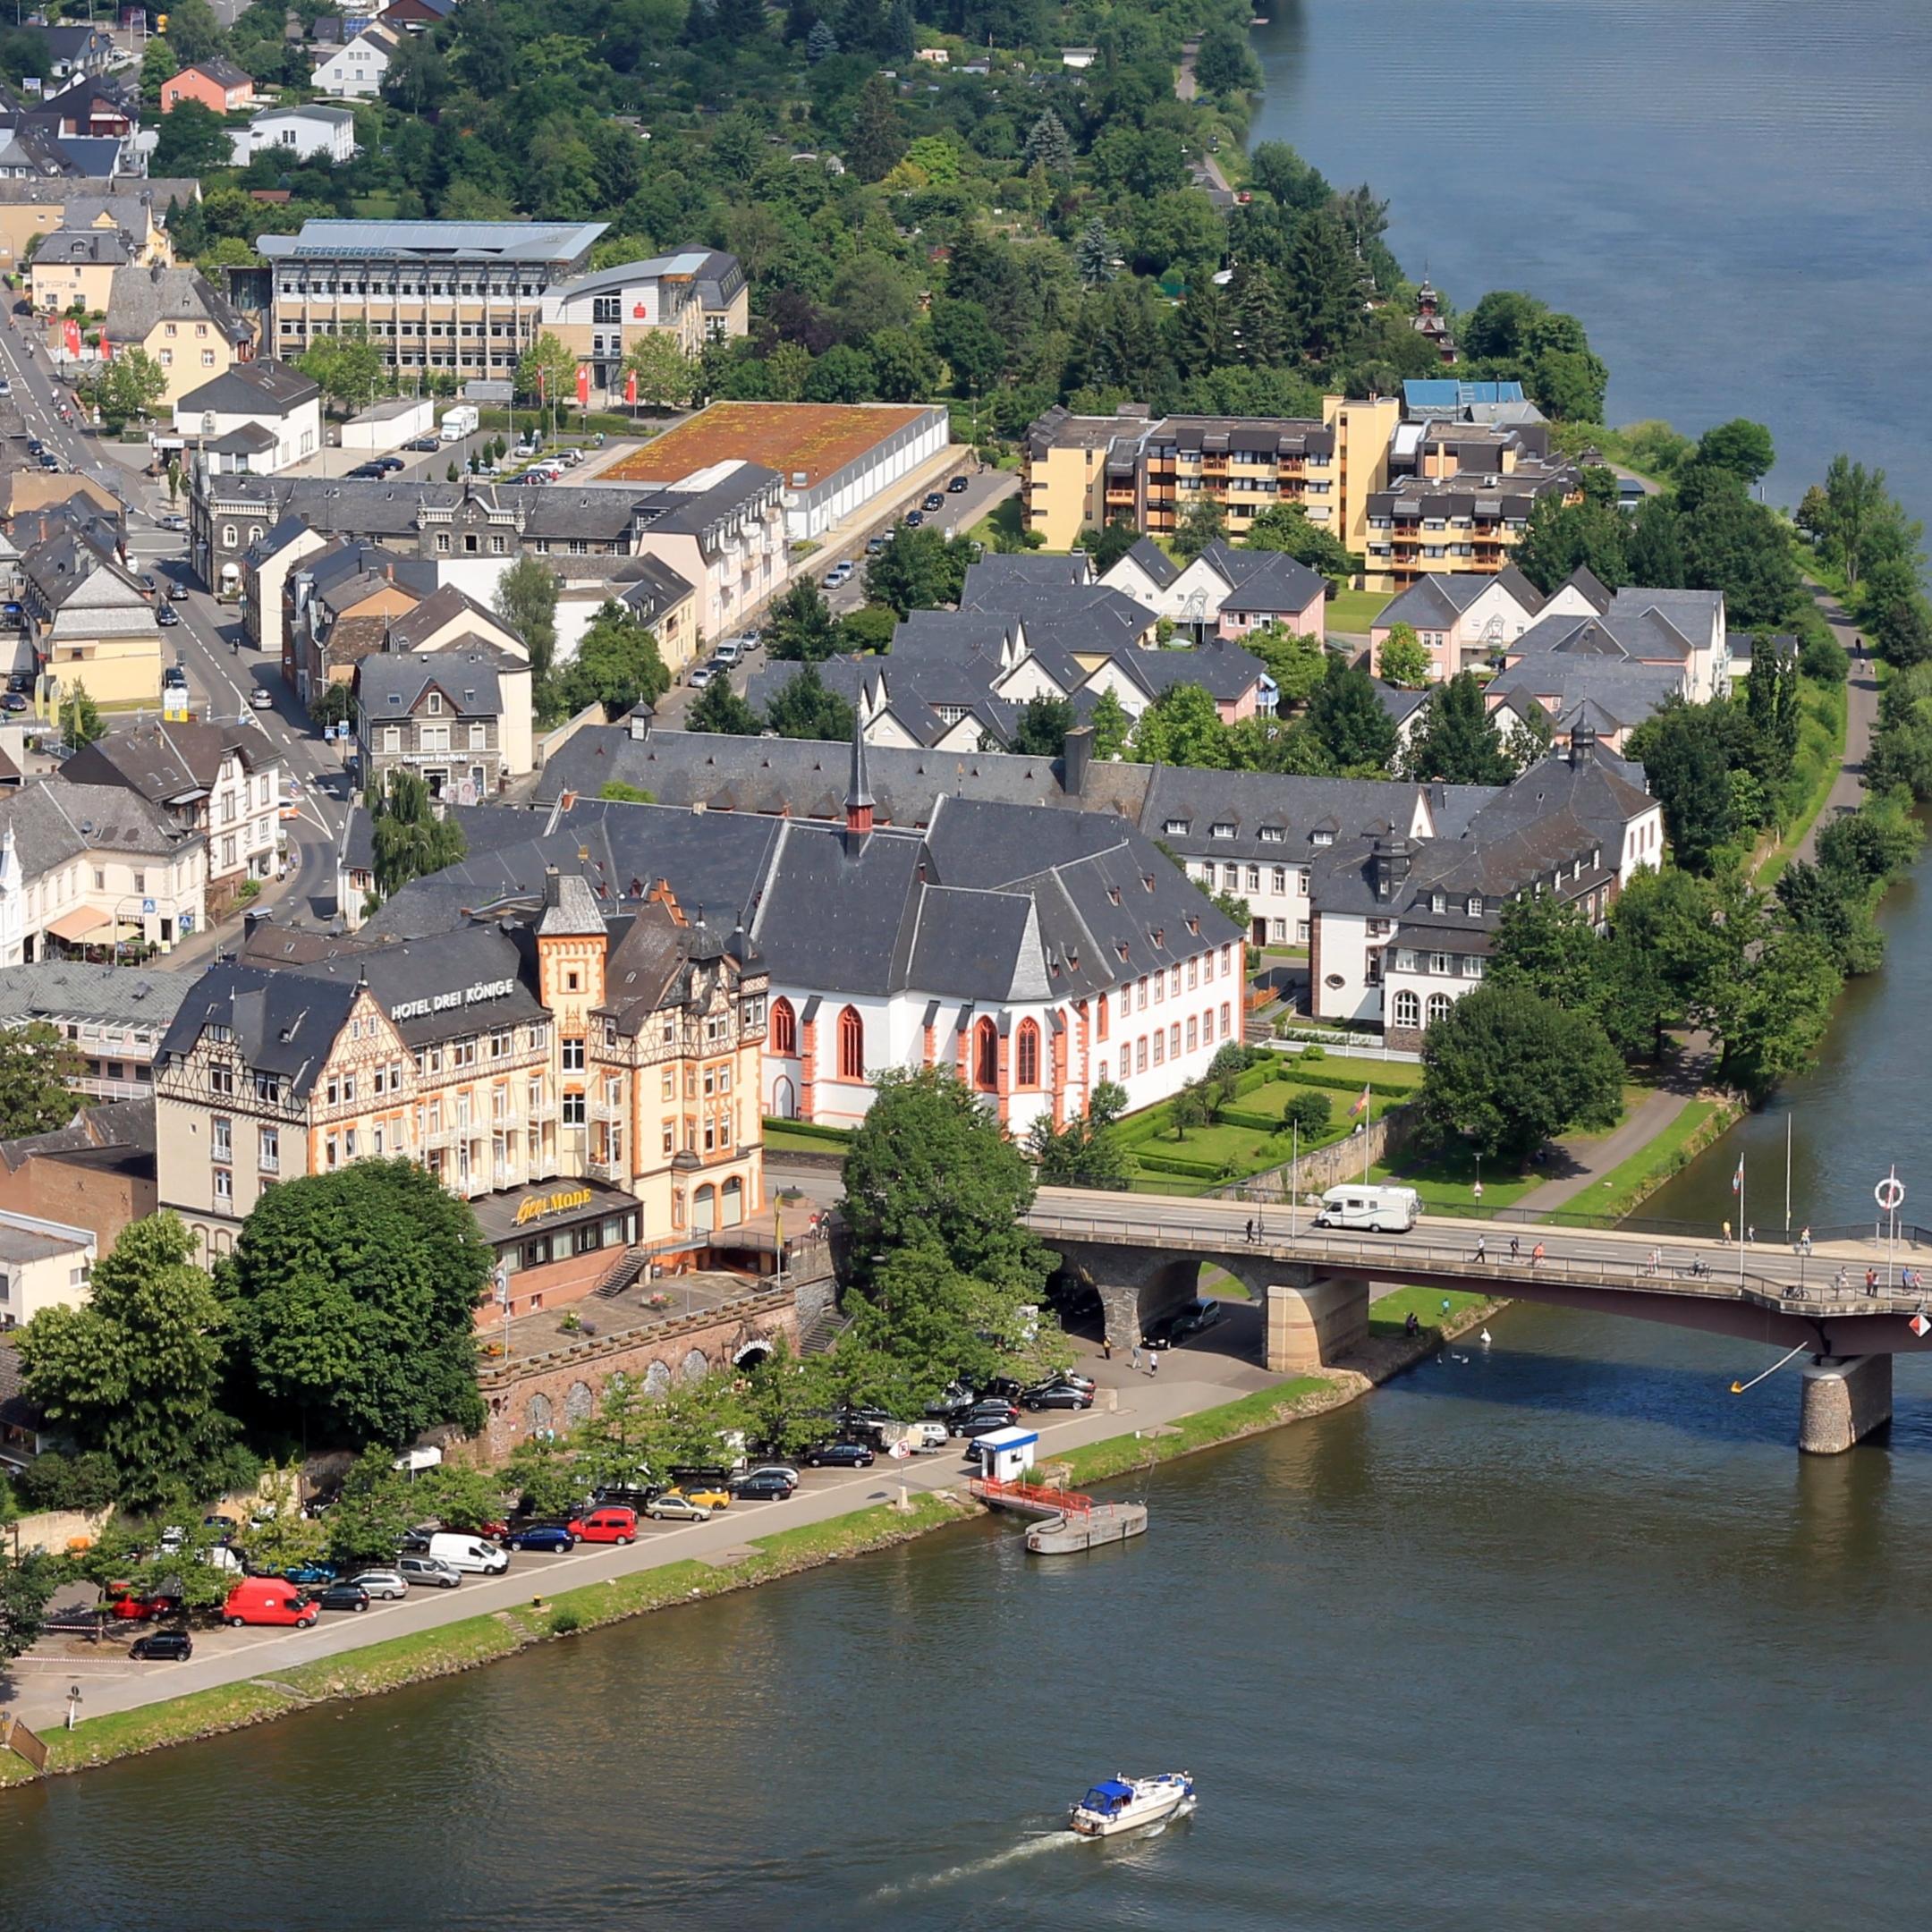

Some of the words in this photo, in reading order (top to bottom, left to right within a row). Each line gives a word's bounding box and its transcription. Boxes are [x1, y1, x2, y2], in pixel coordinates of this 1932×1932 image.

[391, 999, 431, 1021] HOTEL
[433, 991, 462, 1009] DREI
[466, 979, 514, 1003] KÖNIGE
